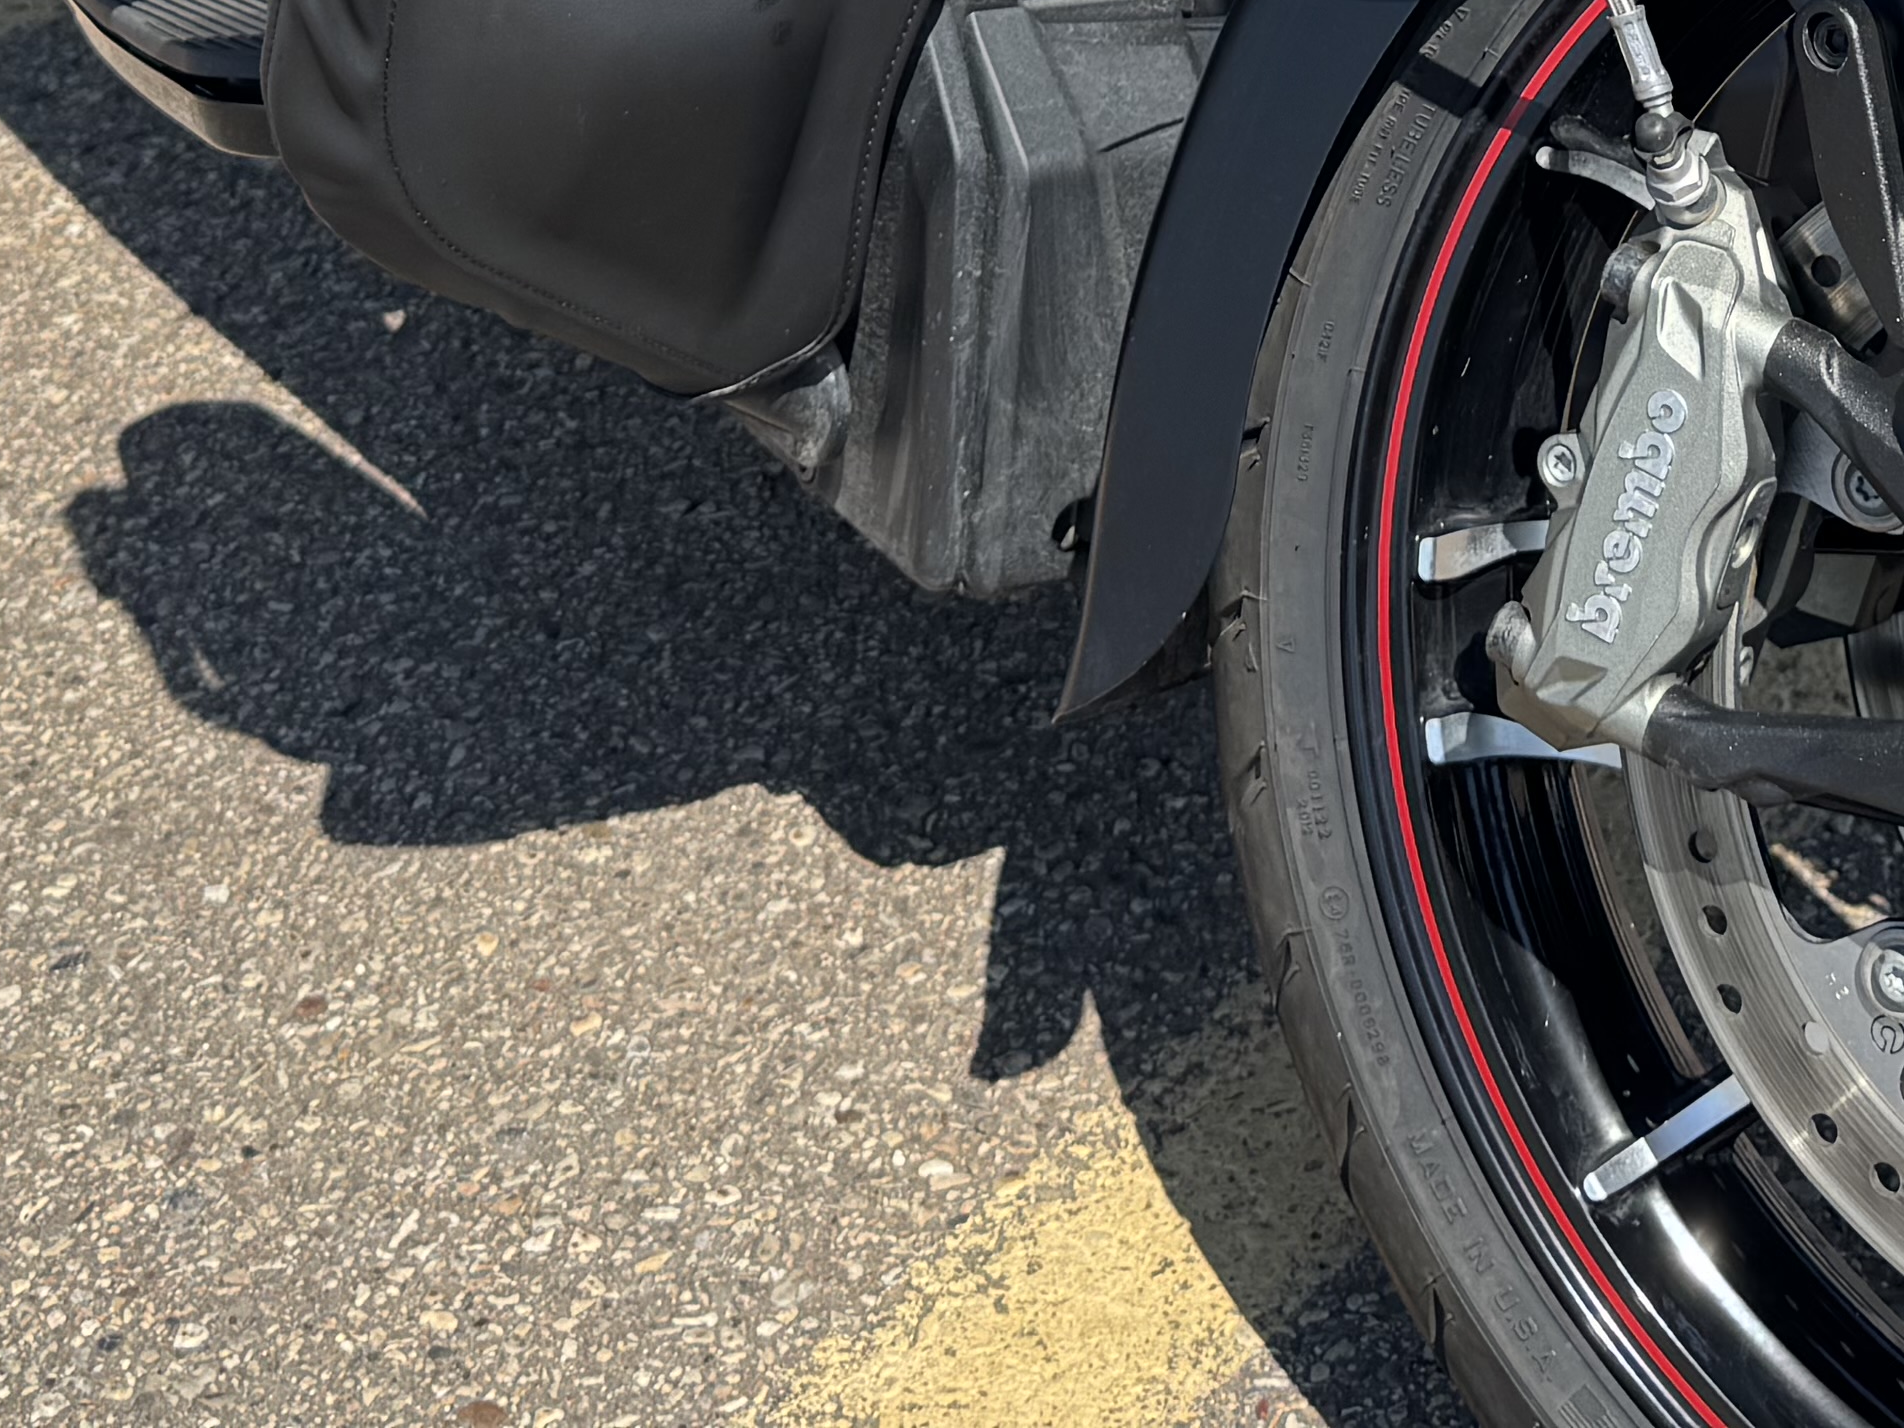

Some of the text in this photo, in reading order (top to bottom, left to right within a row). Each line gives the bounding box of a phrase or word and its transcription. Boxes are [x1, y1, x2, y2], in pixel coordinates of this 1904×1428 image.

[1373, 101, 1437, 210] TUBELESS
[1565, 389, 1688, 644] brembo
[1408, 1129, 1468, 1226] MADE
[1463, 1236, 1497, 1277] IN
